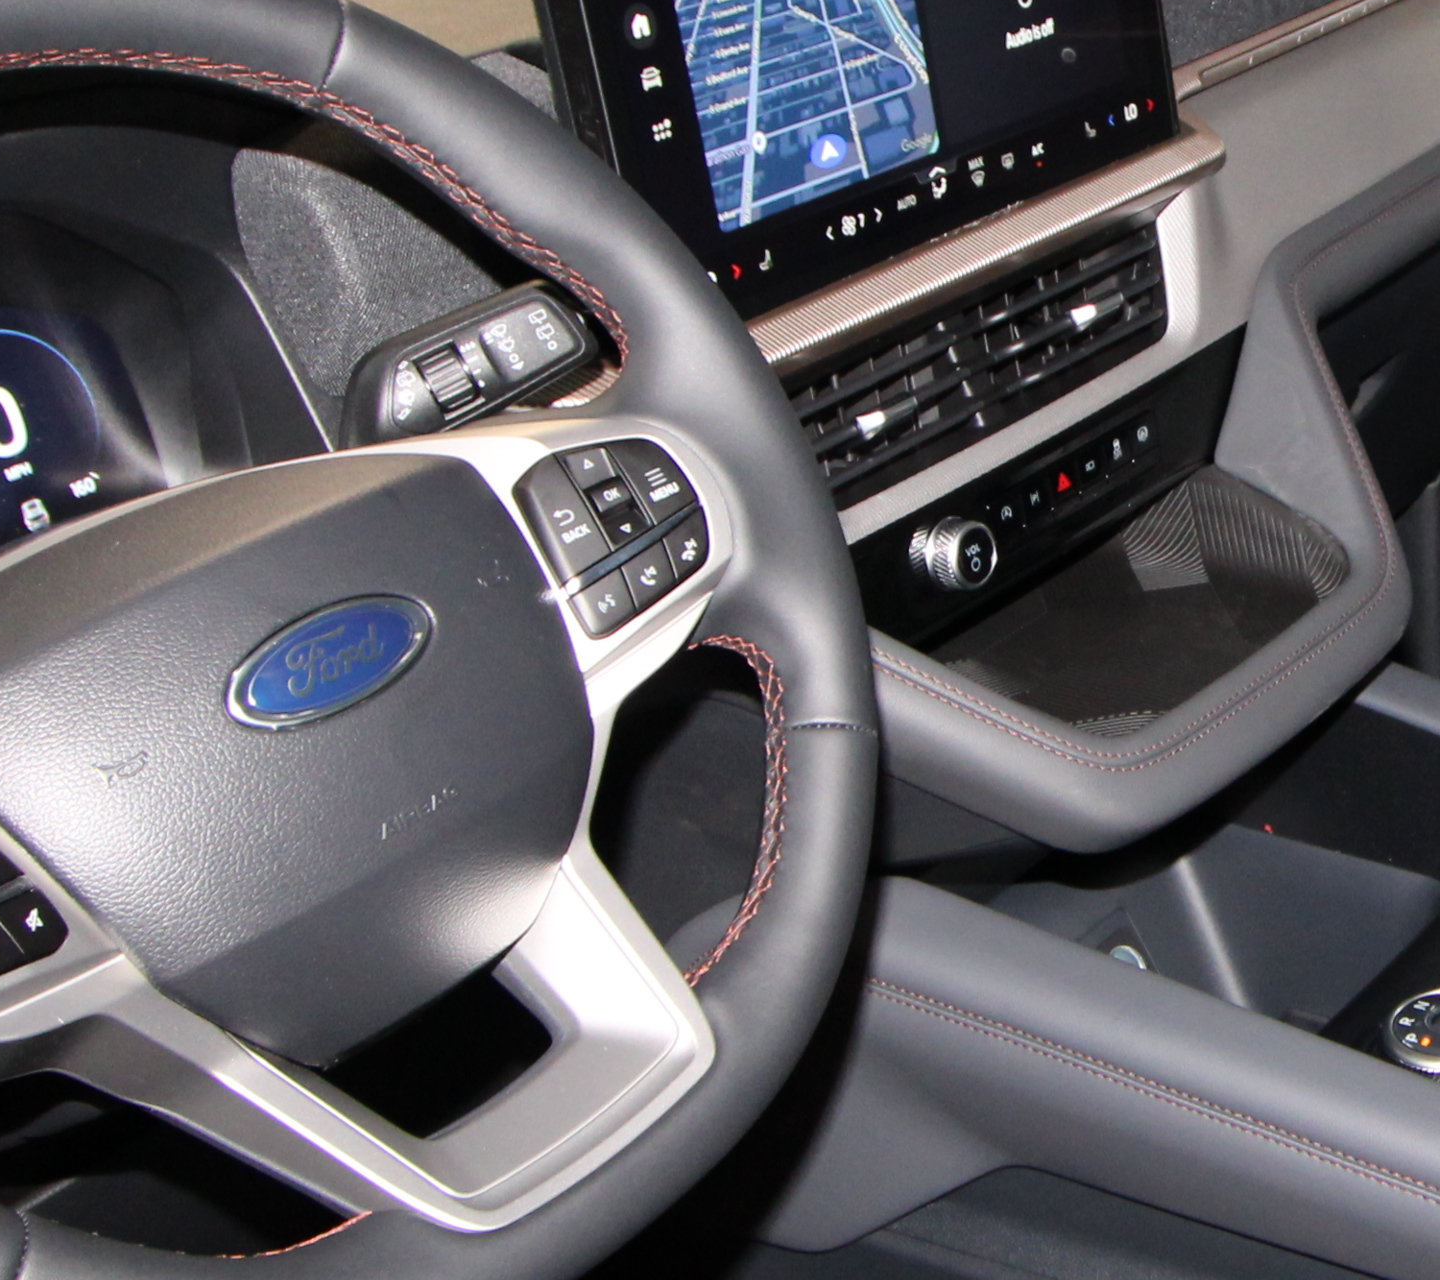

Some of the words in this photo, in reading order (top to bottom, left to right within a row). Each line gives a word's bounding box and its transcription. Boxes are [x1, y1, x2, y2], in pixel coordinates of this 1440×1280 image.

[1006, 28, 1033, 50] Audio
[1032, 24, 1042, 40] is
[1040, 17, 1054, 37] off
[1124, 102, 1138, 122] LO
[901, 132, 933, 152] Google
[968, 156, 984, 170] MAX
[896, 194, 917, 212] AUTO
[2, 461, 34, 482] MPH
[68, 476, 98, 498] 160
[602, 487, 622, 502] OK
[649, 481, 681, 503] MENU
[561, 523, 592, 545] BACK
[964, 542, 982, 557] VOL
[285, 623, 385, 699] Ford
[1398, 1016, 1416, 1028] R
[1413, 1000, 1430, 1012] N
